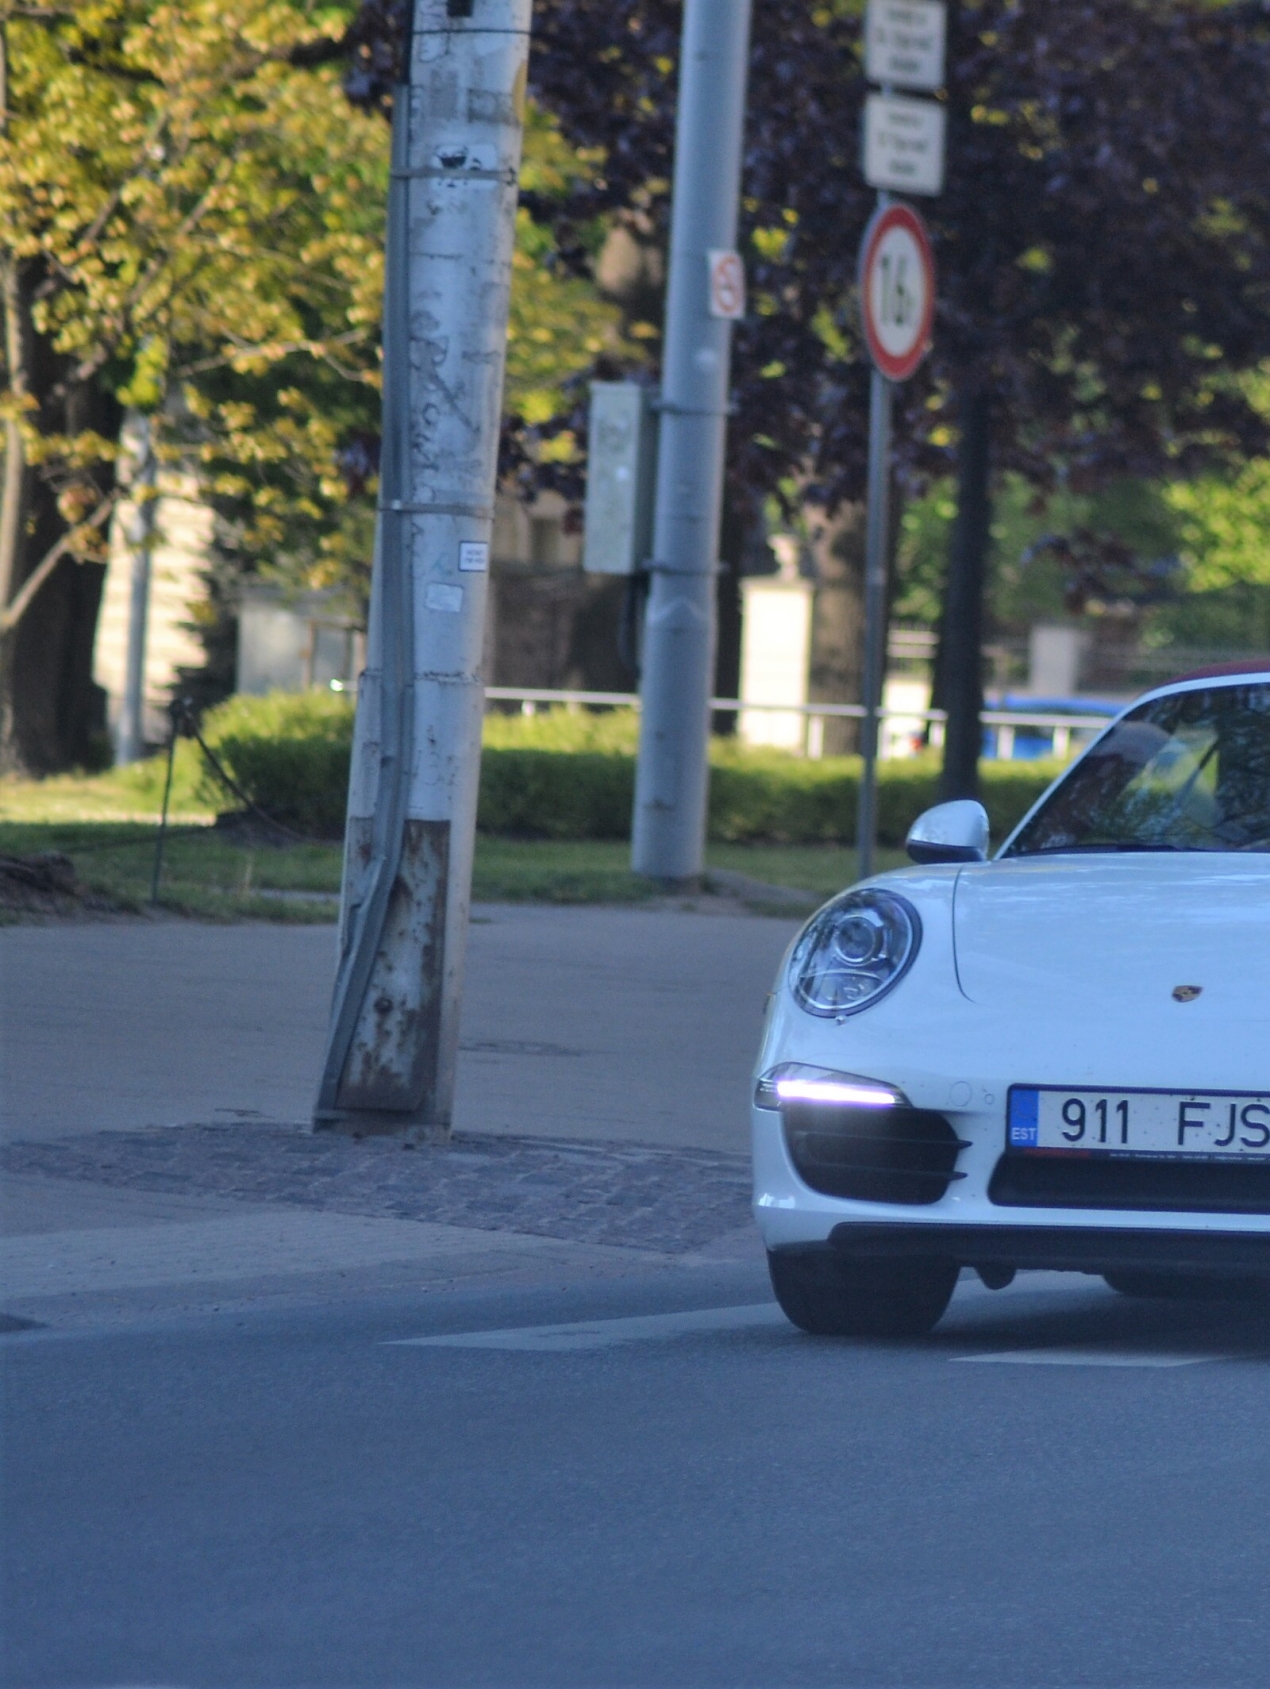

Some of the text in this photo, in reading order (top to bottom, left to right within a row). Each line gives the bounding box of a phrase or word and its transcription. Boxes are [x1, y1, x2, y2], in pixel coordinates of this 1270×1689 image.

[1012, 1128, 1036, 1141] EST
[1062, 1098, 1270, 1148] 911 FJS
